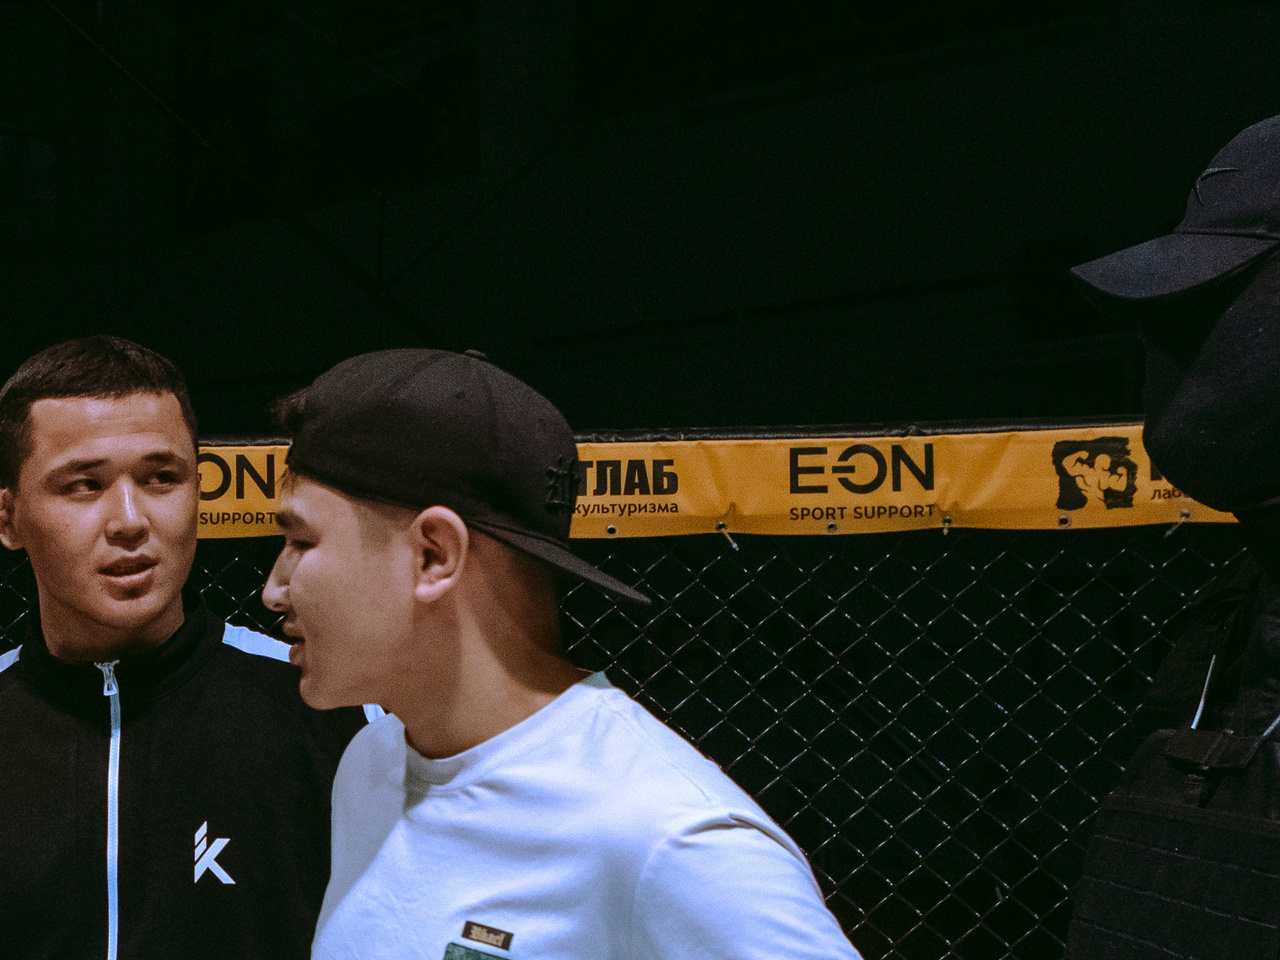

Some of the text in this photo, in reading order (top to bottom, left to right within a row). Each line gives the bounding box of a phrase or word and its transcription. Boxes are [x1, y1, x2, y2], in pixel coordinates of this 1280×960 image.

[199, 512, 276, 525] SUPPORT
[789, 504, 936, 521] SPORT SUPPORT
